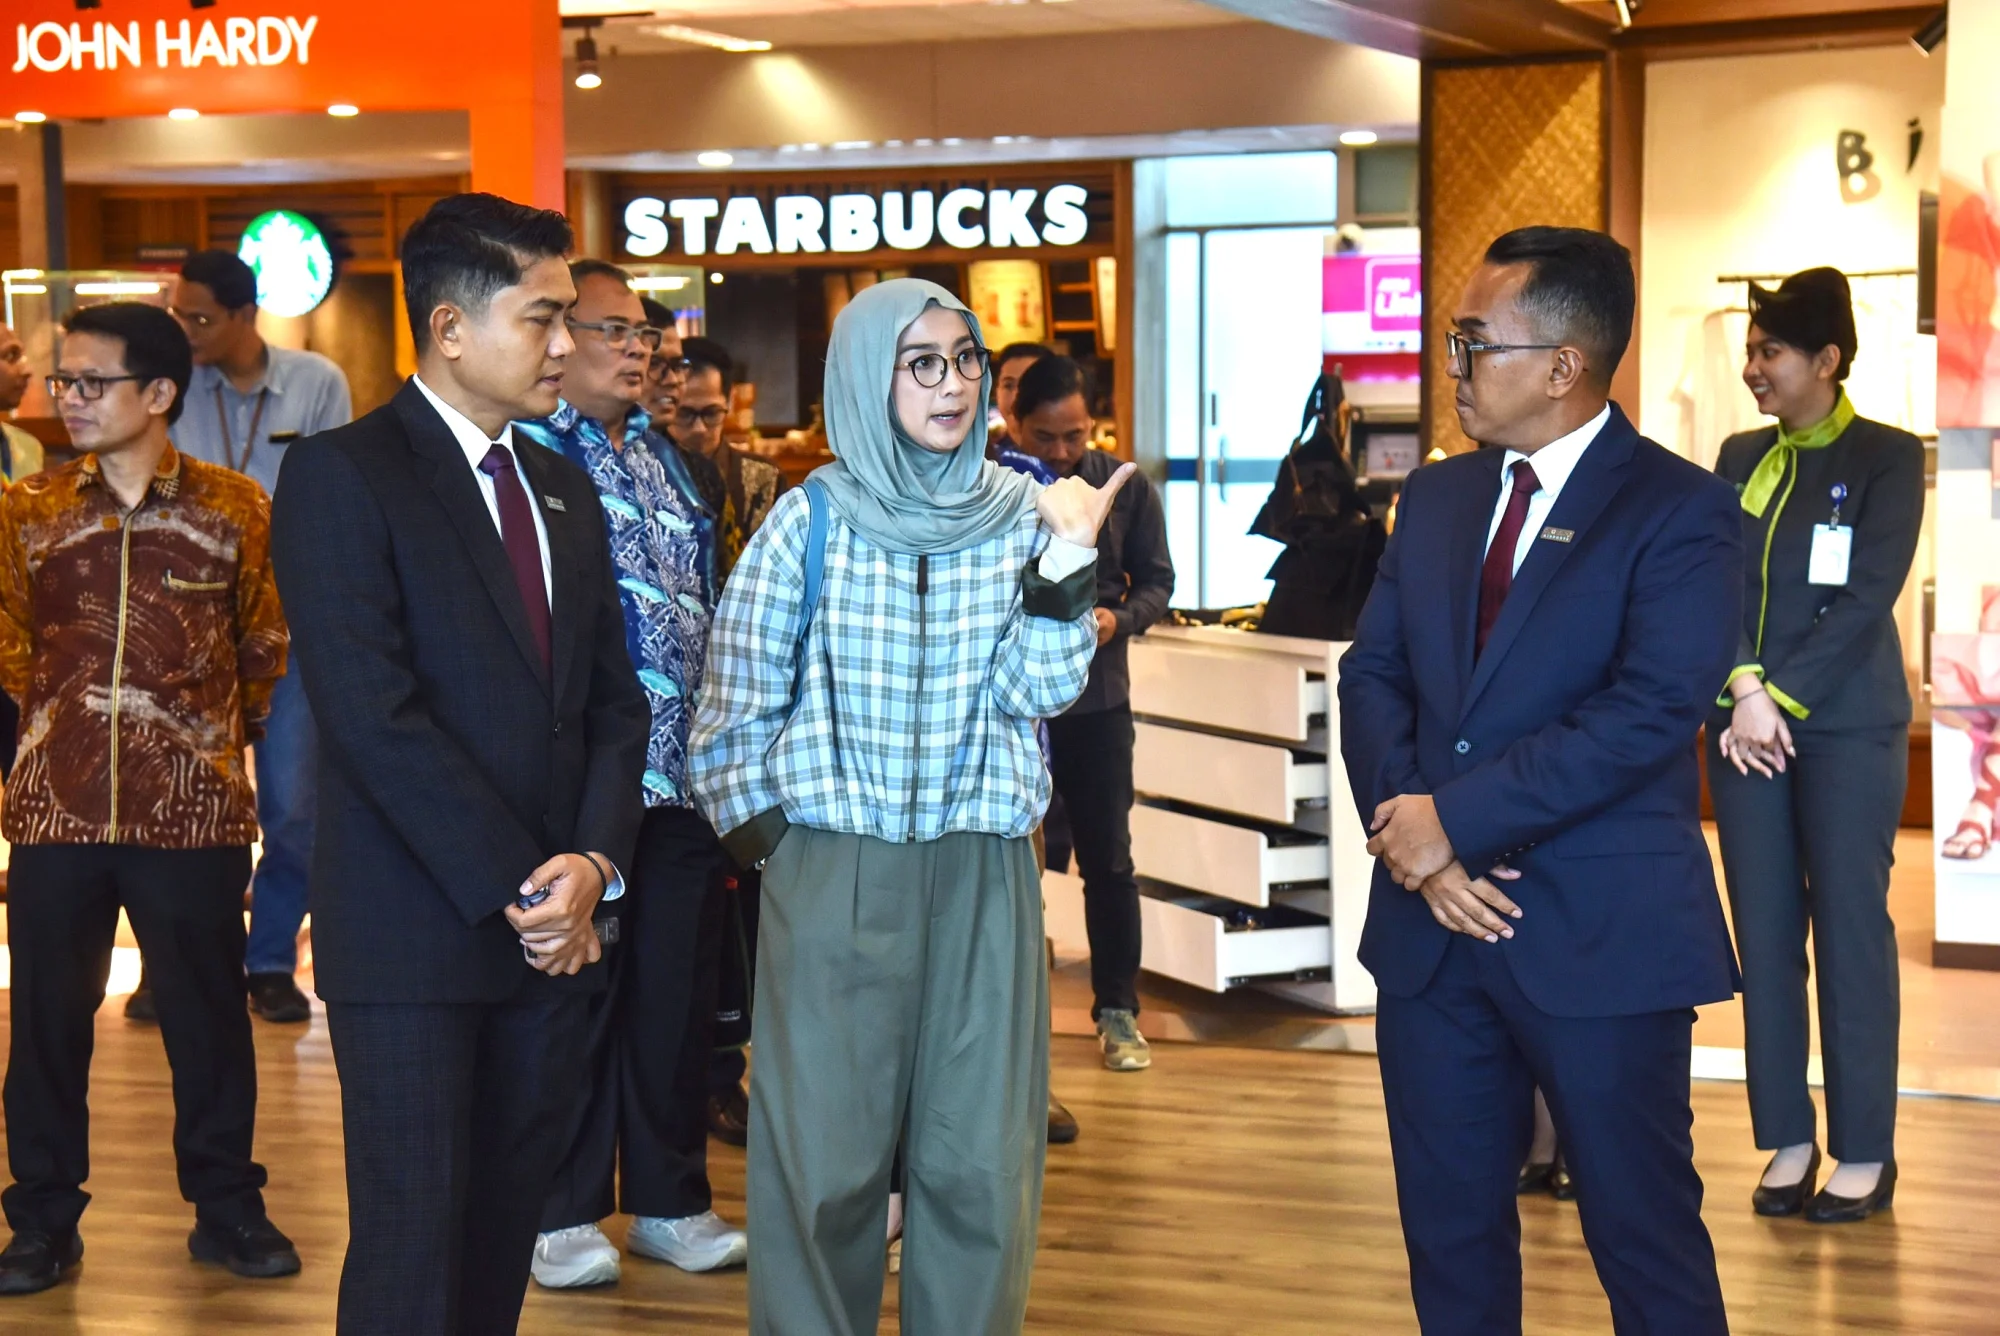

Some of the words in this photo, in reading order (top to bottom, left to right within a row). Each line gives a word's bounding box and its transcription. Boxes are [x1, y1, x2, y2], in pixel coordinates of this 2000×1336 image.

[12, 21, 141, 73] JOHN
[155, 15, 318, 67] HARDY
[624, 185, 1088, 256] STARBUCKS
